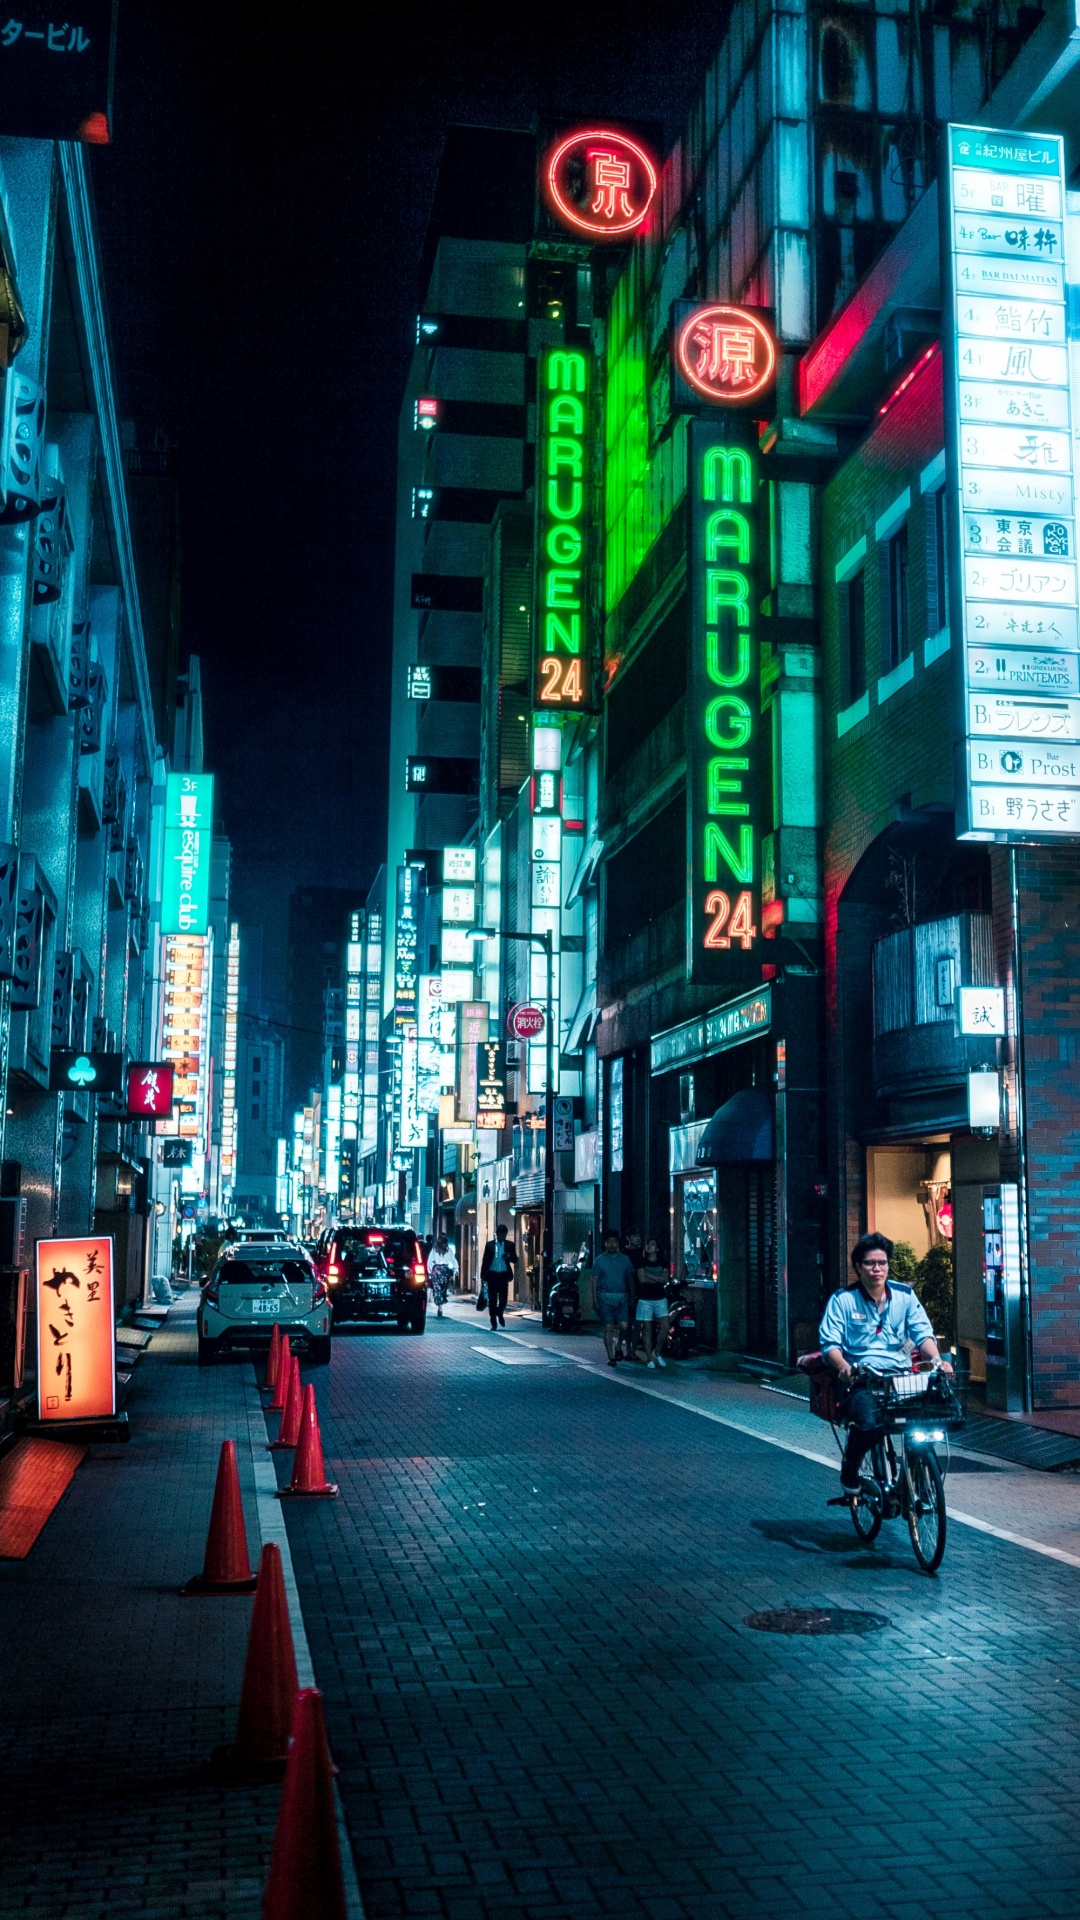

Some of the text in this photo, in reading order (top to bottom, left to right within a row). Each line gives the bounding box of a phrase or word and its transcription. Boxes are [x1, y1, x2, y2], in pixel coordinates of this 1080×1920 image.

[1, 19, 91, 53] タービル
[982, 145, 1056, 165] 紀州屋ビル
[981, 270, 1001, 282] BAR
[1002, 272, 1058, 286] DALMATIAN
[693, 320, 757, 392] 源
[1000, 346, 1052, 382] 風
[1006, 399, 1046, 418] あきこ
[1015, 484, 1065, 505] Misty
[996, 518, 1032, 537] 東京
[997, 536, 1034, 555] 会議
[999, 568, 1067, 594] ゴリアン
[541, 656, 583, 703] 24
[1009, 670, 1070, 685] PRINTEMPS
[995, 710, 1071, 735] フレンズ
[1030, 758, 1077, 777] Prost
[1046, 752, 1060, 762] Bar
[182, 778, 198, 792] 3F
[1006, 797, 1076, 822] 野うさぎ
[173, 829, 197, 891] esquire
[179, 893, 198, 931] club
[702, 891, 757, 950] 24
[517, 1016, 543, 1029] 消火栓
[971, 1006, 997, 1029] 誠
[565, 1122, 573, 1145] おでん
[84, 1249, 105, 1302] 美里
[42, 1266, 82, 1402] やきとり
